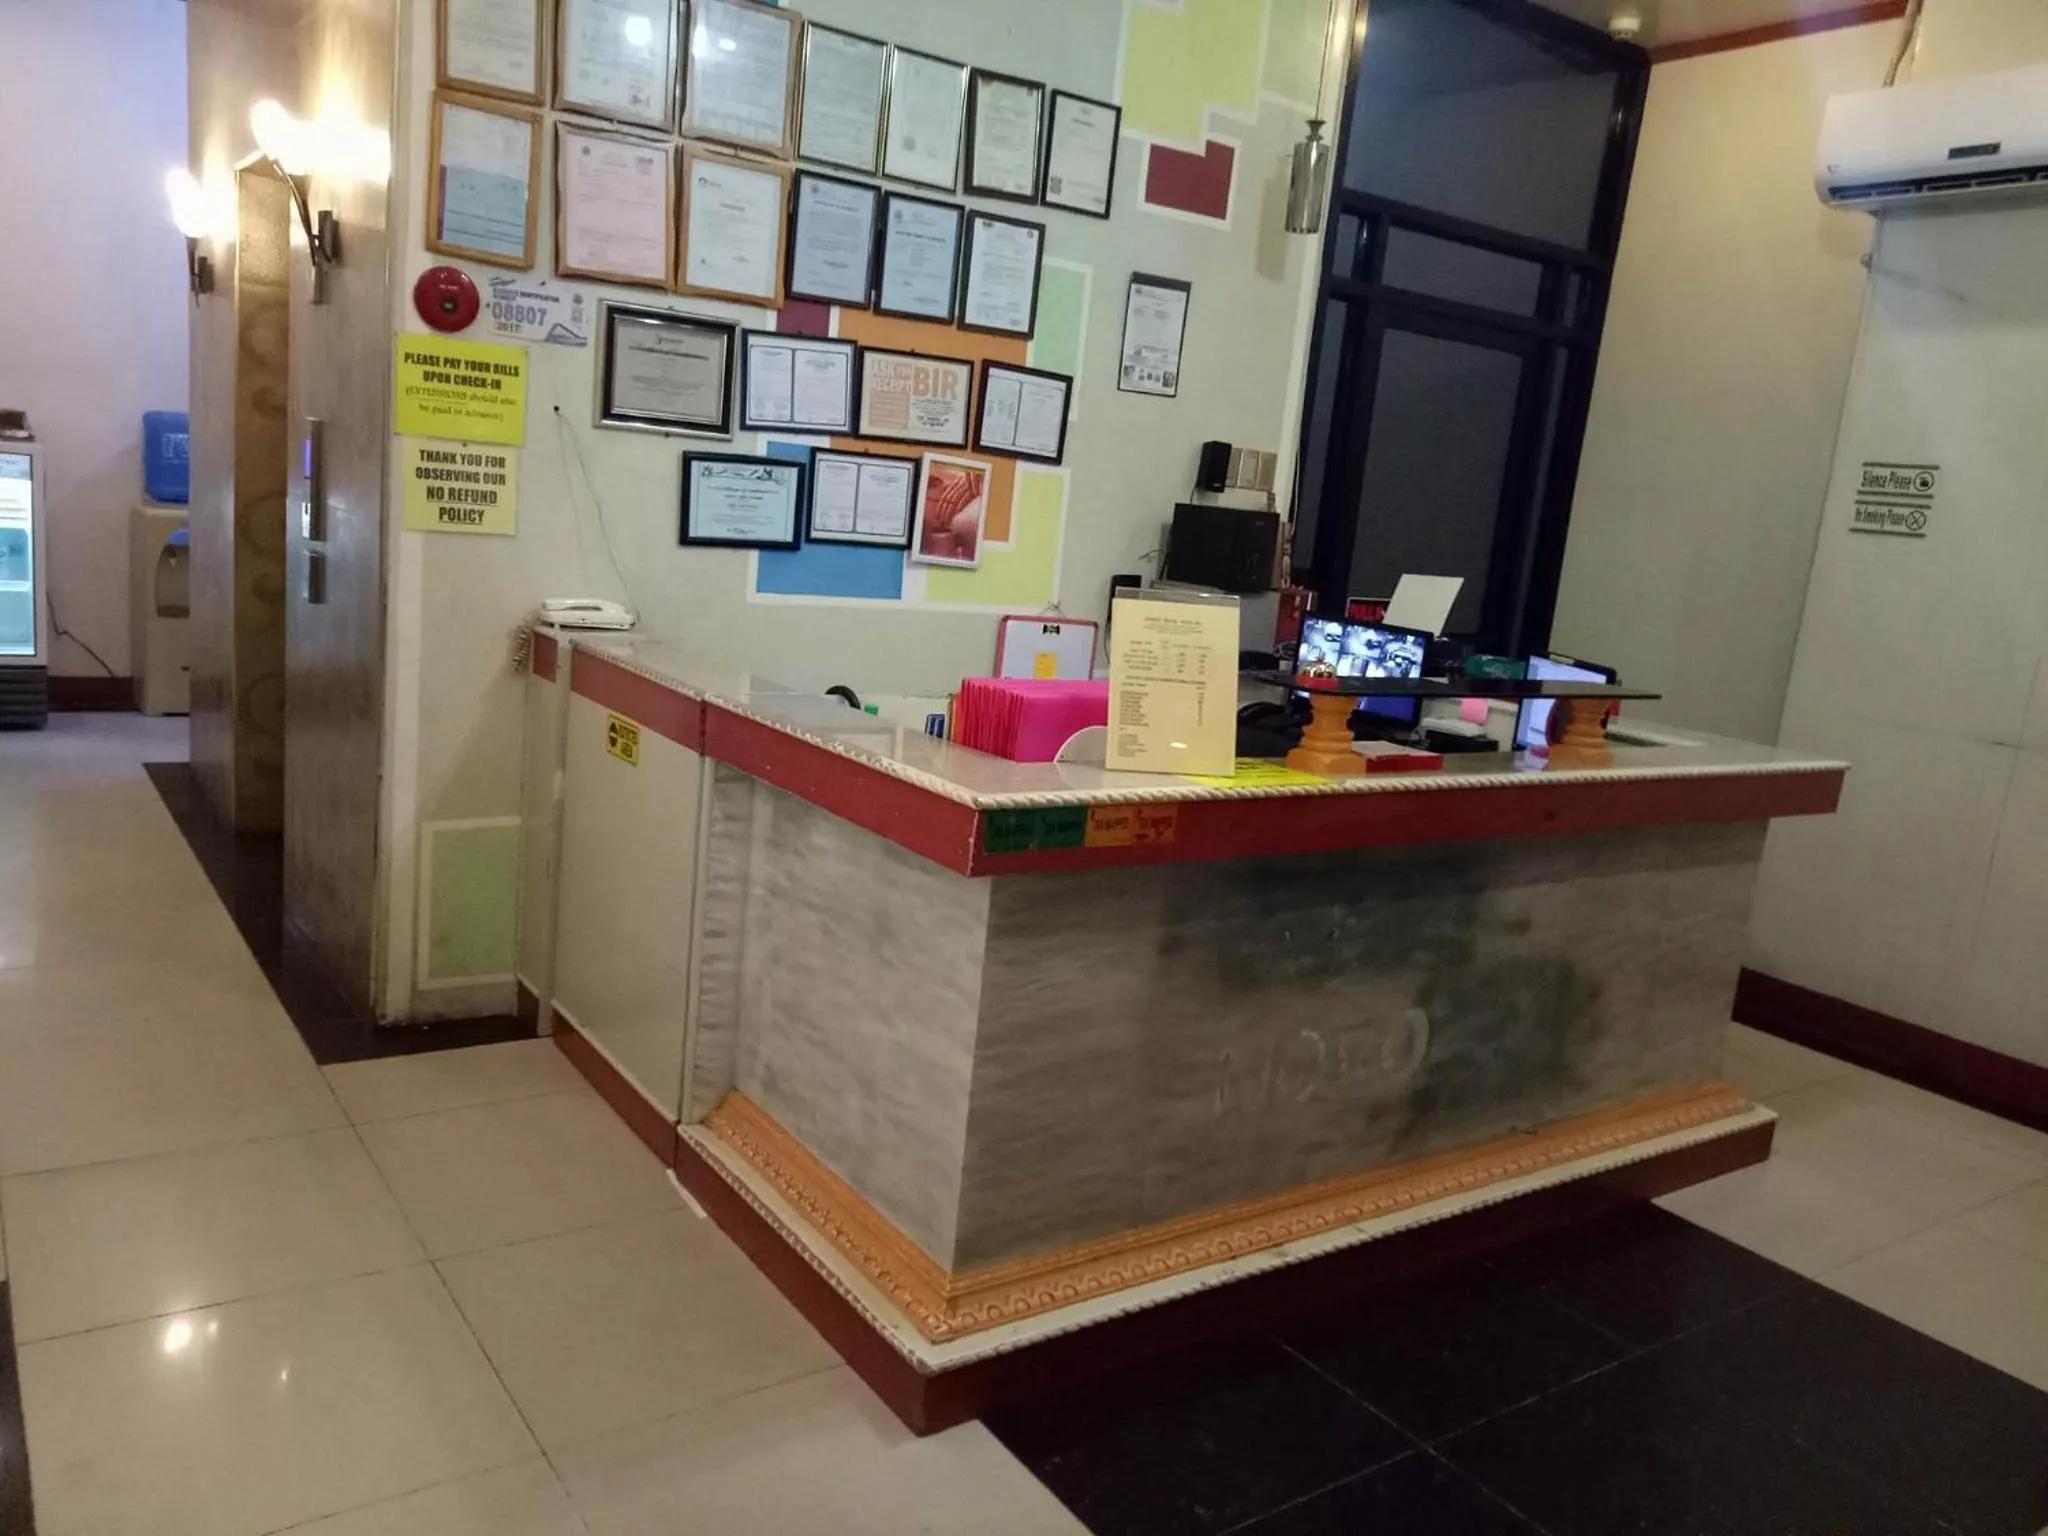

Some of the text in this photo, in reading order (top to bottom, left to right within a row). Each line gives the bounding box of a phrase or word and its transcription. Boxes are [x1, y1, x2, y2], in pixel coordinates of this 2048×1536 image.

[492, 301, 547, 326] 08807
[404, 352, 519, 377] PLEASE PAY YOUR BILLS
[423, 370, 501, 390] UPON CHECK-IN
[912, 365, 959, 401] BIR
[419, 449, 506, 469] THANK YOU FOR
[415, 466, 506, 485] OBSERVING OUR
[1861, 470, 1912, 489] Silence Please
[426, 485, 498, 505] NO REFUND
[439, 506, 485, 523] POLICY
